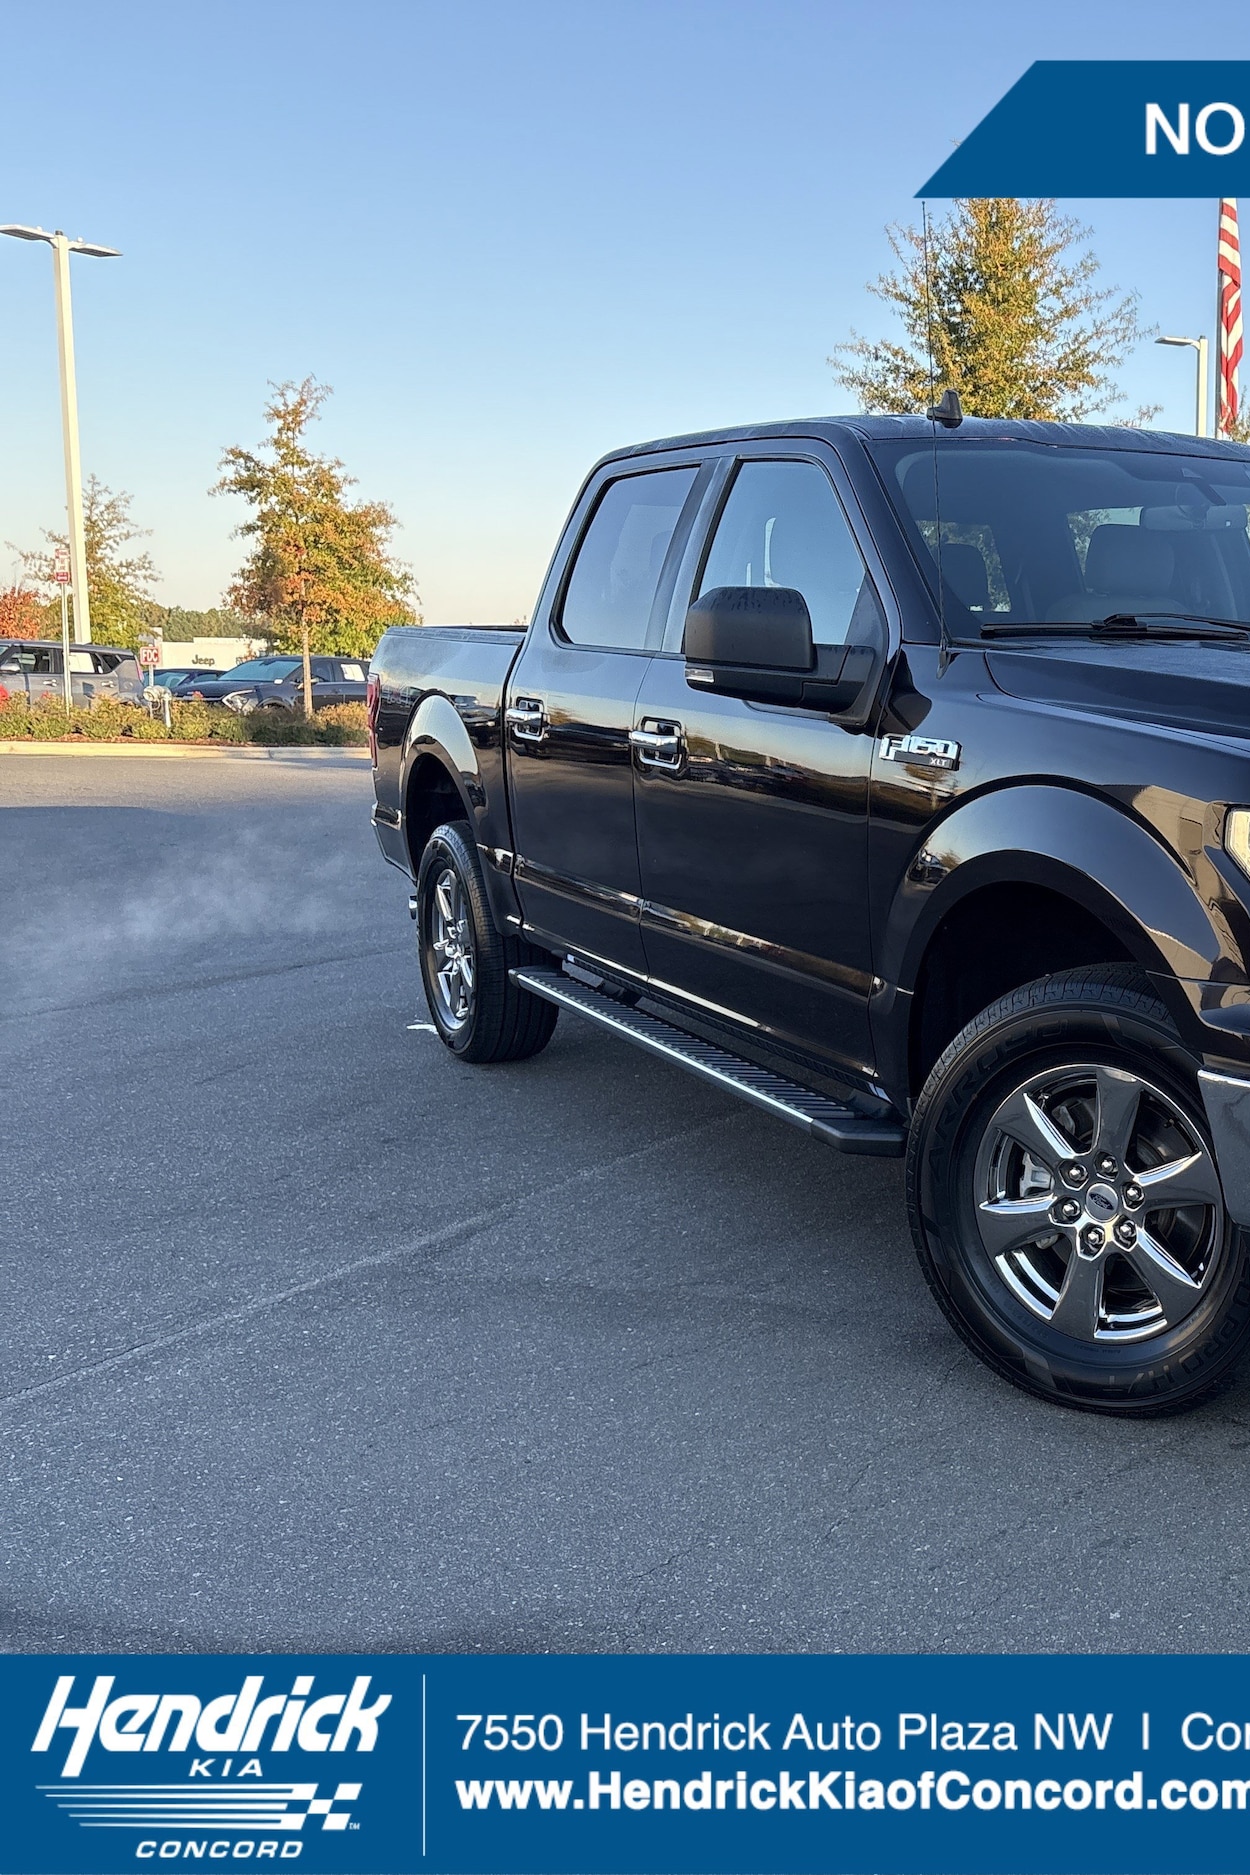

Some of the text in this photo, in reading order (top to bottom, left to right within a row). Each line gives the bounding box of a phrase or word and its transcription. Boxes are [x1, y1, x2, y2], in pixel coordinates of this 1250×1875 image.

[142, 649, 158, 662] FDC
[192, 654, 215, 666] Jeep
[930, 757, 947, 766] XLT
